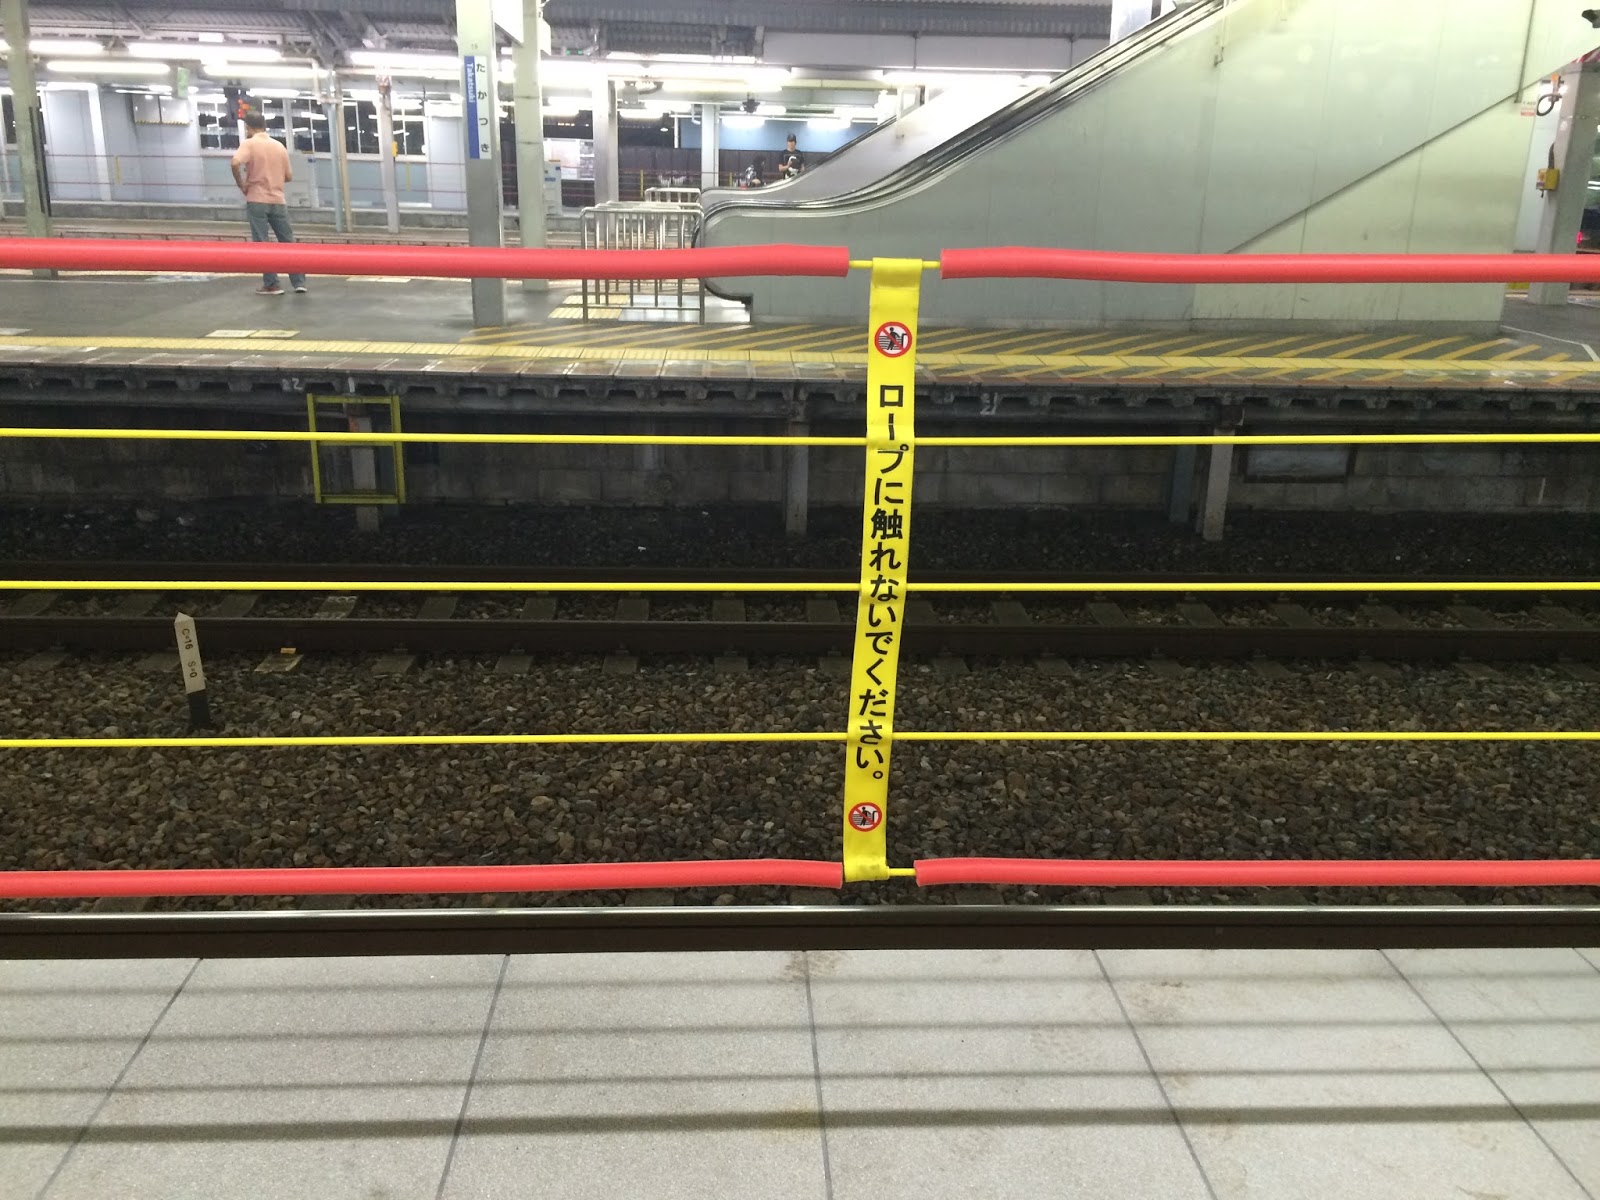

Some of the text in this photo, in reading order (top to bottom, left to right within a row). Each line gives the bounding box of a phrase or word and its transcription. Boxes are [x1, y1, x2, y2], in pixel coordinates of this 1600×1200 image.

[466, 63, 476, 103] Takatsuki
[476, 62, 490, 153] たかつき
[856, 384, 910, 780] ロープに触れないでください。
